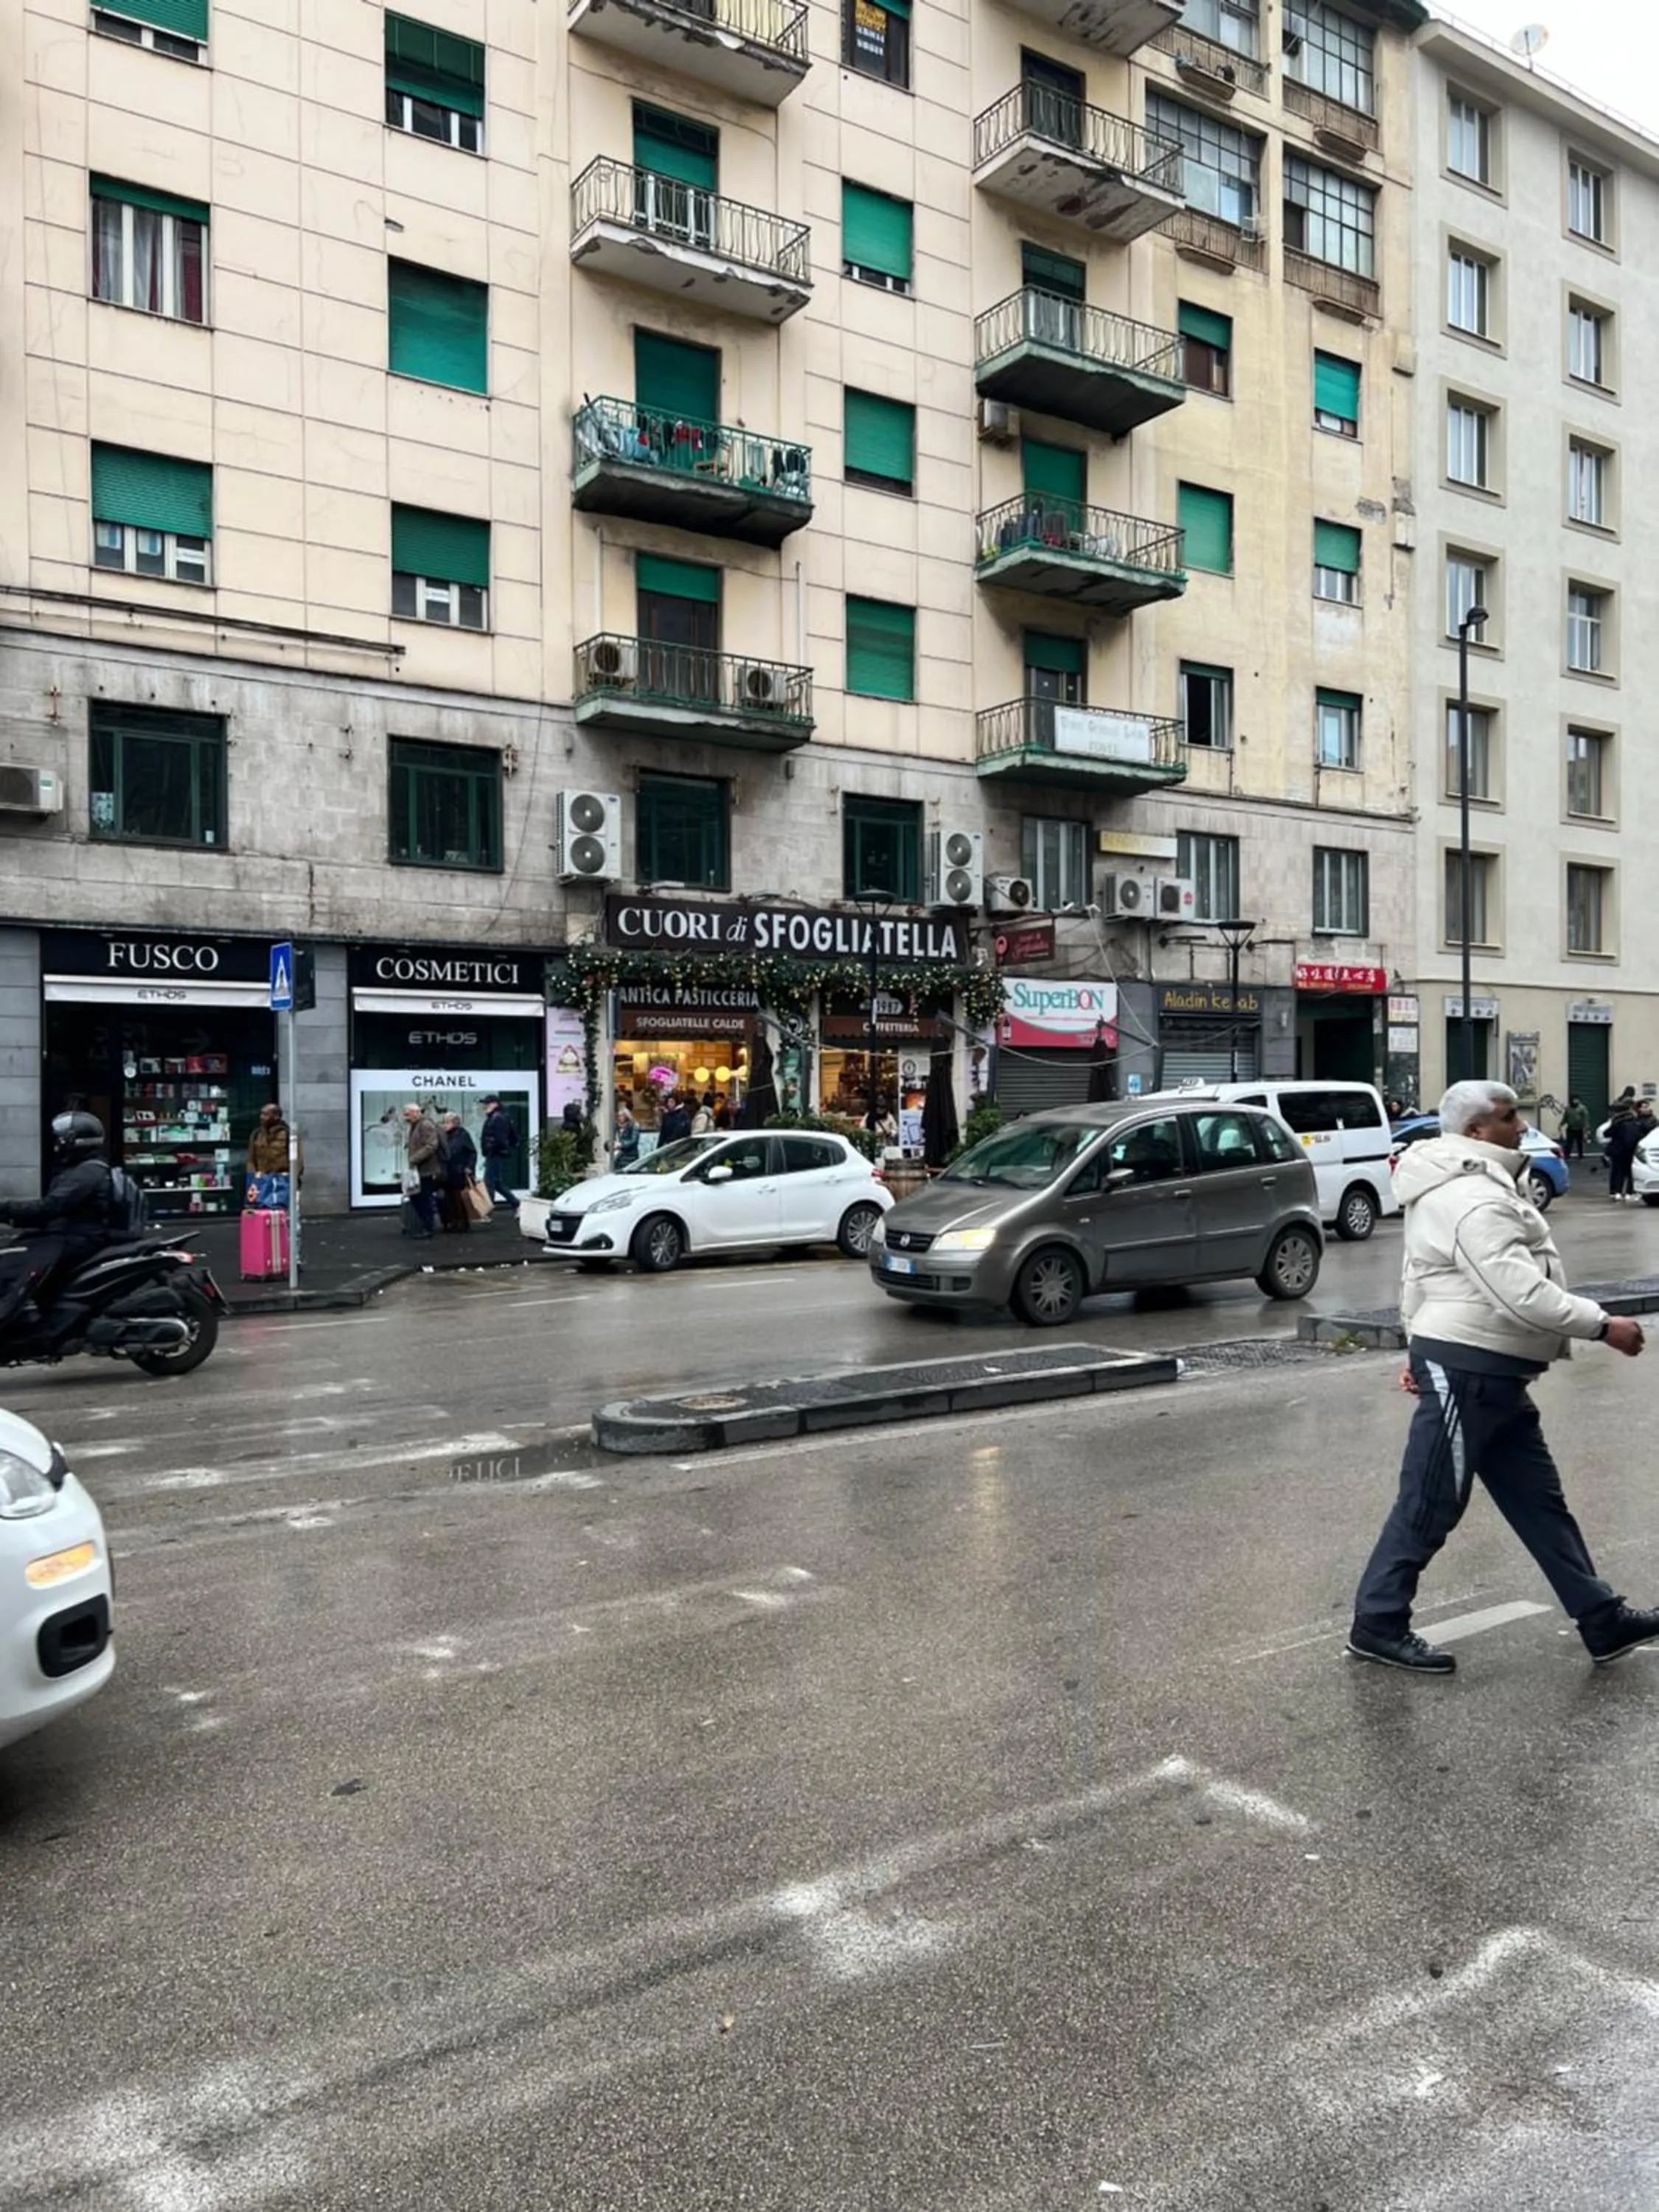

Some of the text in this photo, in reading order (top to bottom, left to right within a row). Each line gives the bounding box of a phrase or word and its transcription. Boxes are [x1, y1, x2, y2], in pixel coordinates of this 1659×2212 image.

[618, 908, 721, 940] CUORI
[726, 916, 748, 942] di
[107, 942, 219, 971] FUSCO
[376, 957, 519, 984] COSMETICI
[137, 988, 187, 1000] ETHOS
[619, 986, 759, 1007] ANTICA PASTICCERIA
[1164, 990, 1259, 1010] Aladin keab
[431, 1001, 473, 1011] ETHOS
[636, 1016, 745, 1029] SFOGLIATELLE CALDE
[862, 1021, 920, 1033] CFFETTERIA
[408, 1031, 478, 1045] ETHOS
[411, 1075, 477, 1088] CHANEL
